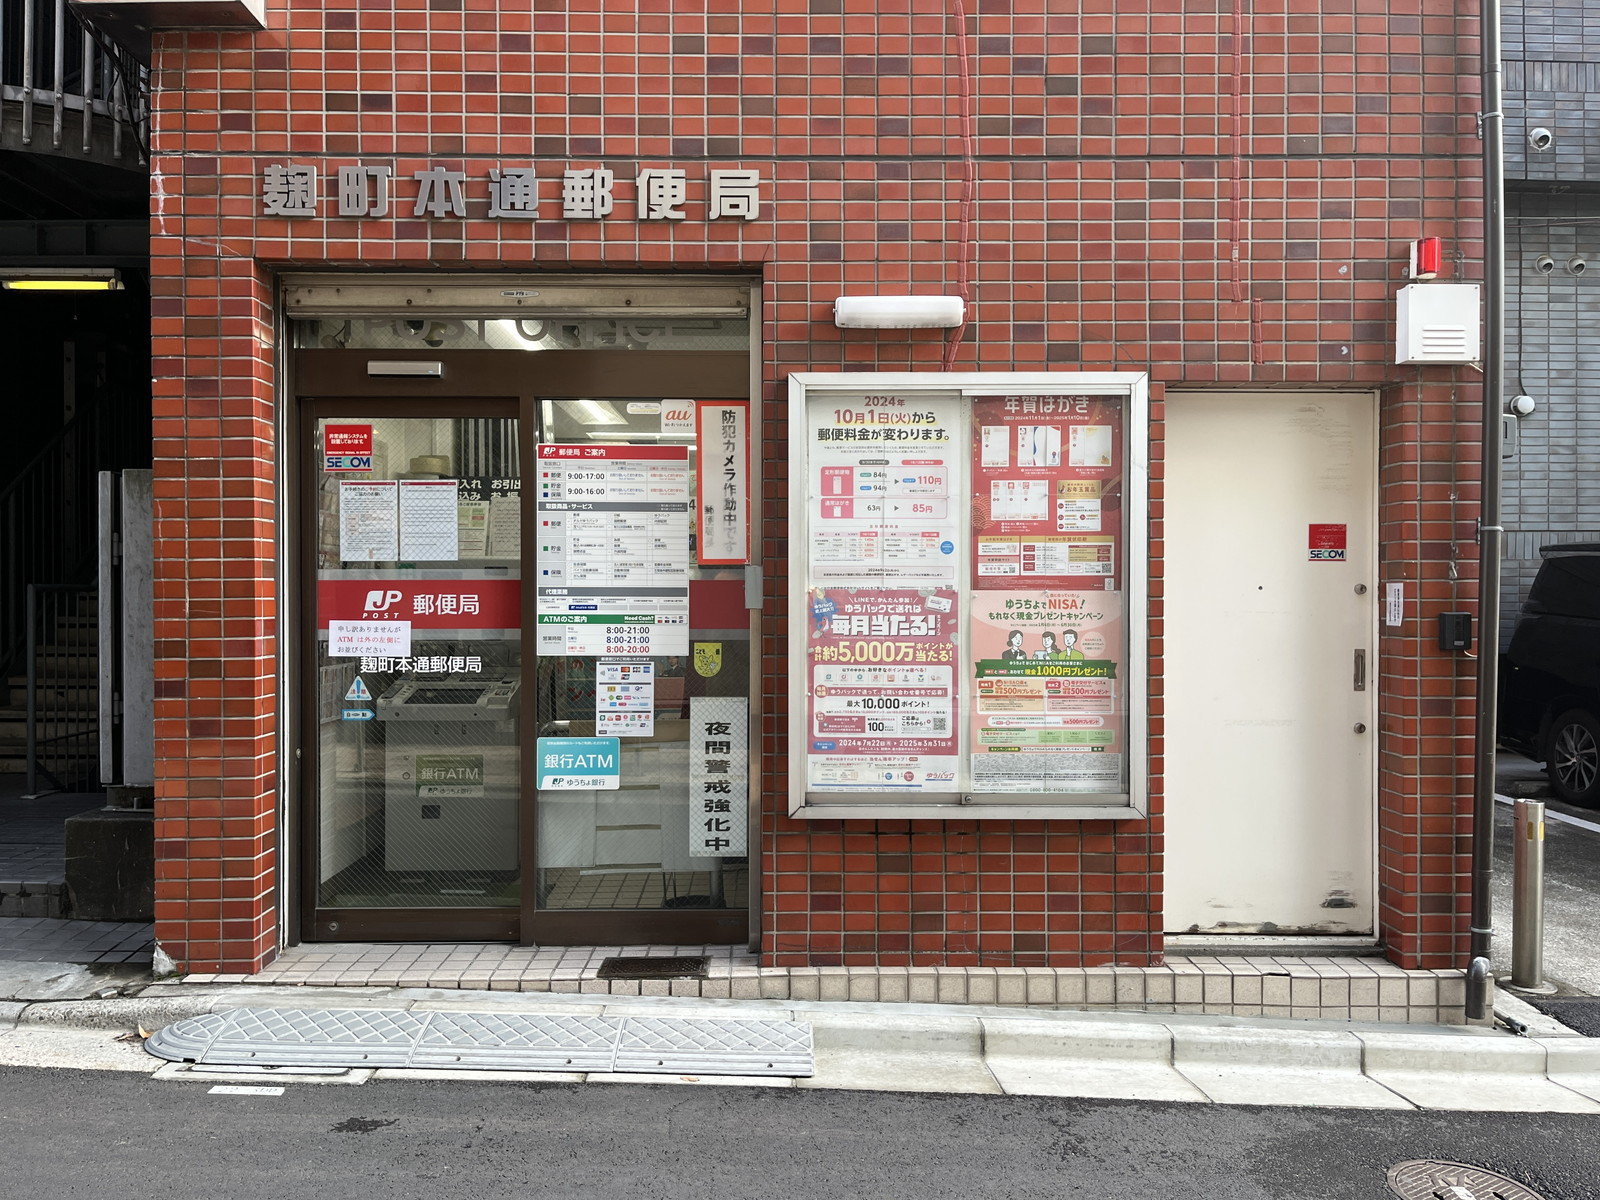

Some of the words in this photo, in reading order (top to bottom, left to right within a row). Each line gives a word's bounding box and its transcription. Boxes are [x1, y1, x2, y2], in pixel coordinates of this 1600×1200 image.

[262, 164, 760, 221] 麹町本通郵便局
[864, 396, 906, 407] 2024年
[1004, 396, 1089, 414] 年賀はがき
[666, 410, 693, 421] au
[834, 409, 937, 424] 10月1日(火)から
[817, 427, 950, 442] 郵便料金が変わります。
[327, 457, 371, 468] SECOM
[721, 409, 737, 555] 防犯カメラ作動中です
[917, 475, 942, 486] 110円
[912, 503, 933, 513] 85円
[1310, 550, 1344, 559] SECOM
[364, 590, 402, 611] JP
[413, 594, 480, 615] 郵便局
[1005, 599, 1085, 610] ゆうちょでNISA!
[844, 604, 922, 613] ゆうパックで送れば
[988, 611, 1104, 621] もれなく現金プレゼントキャンペーン
[831, 614, 937, 636] 毎月当たる!
[915, 650, 953, 662] 当たる!
[360, 656, 482, 674] 麹町本通郵便局
[846, 698, 930, 709] 最大10,000ポイント!
[867, 722, 884, 732] 100
[544, 754, 613, 769] 銀行ATM
[421, 767, 479, 780] 銀行ATM
